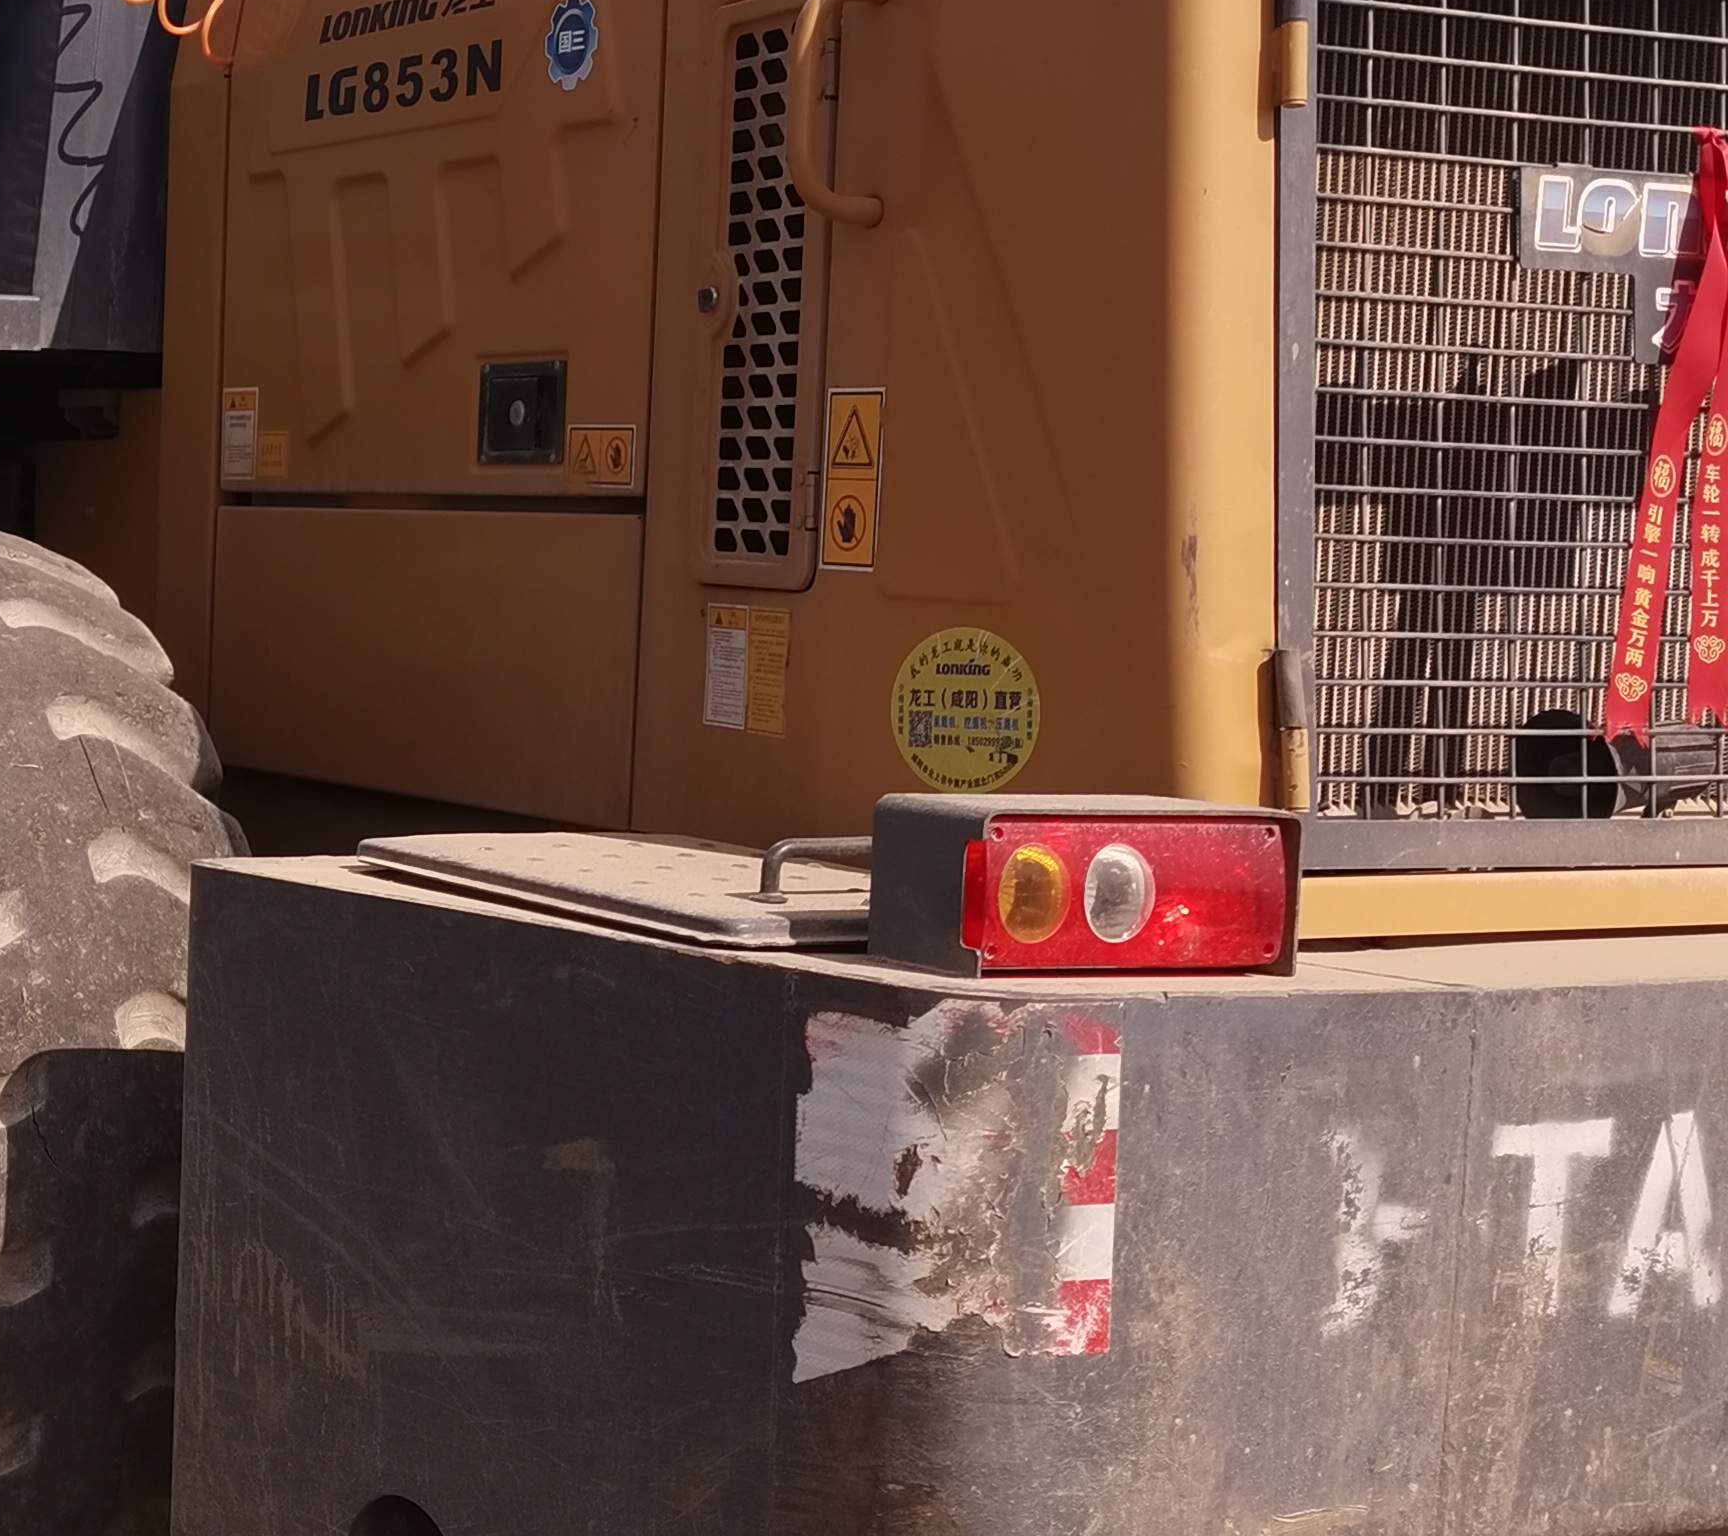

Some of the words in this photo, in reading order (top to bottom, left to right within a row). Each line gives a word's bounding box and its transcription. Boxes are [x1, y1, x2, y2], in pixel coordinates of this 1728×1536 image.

[304, 39, 503, 121] LG853N
[1708, 418, 1725, 449] 福
[1653, 459, 1671, 493] 福
[1699, 464, 1721, 628] 车轮一转成千上万
